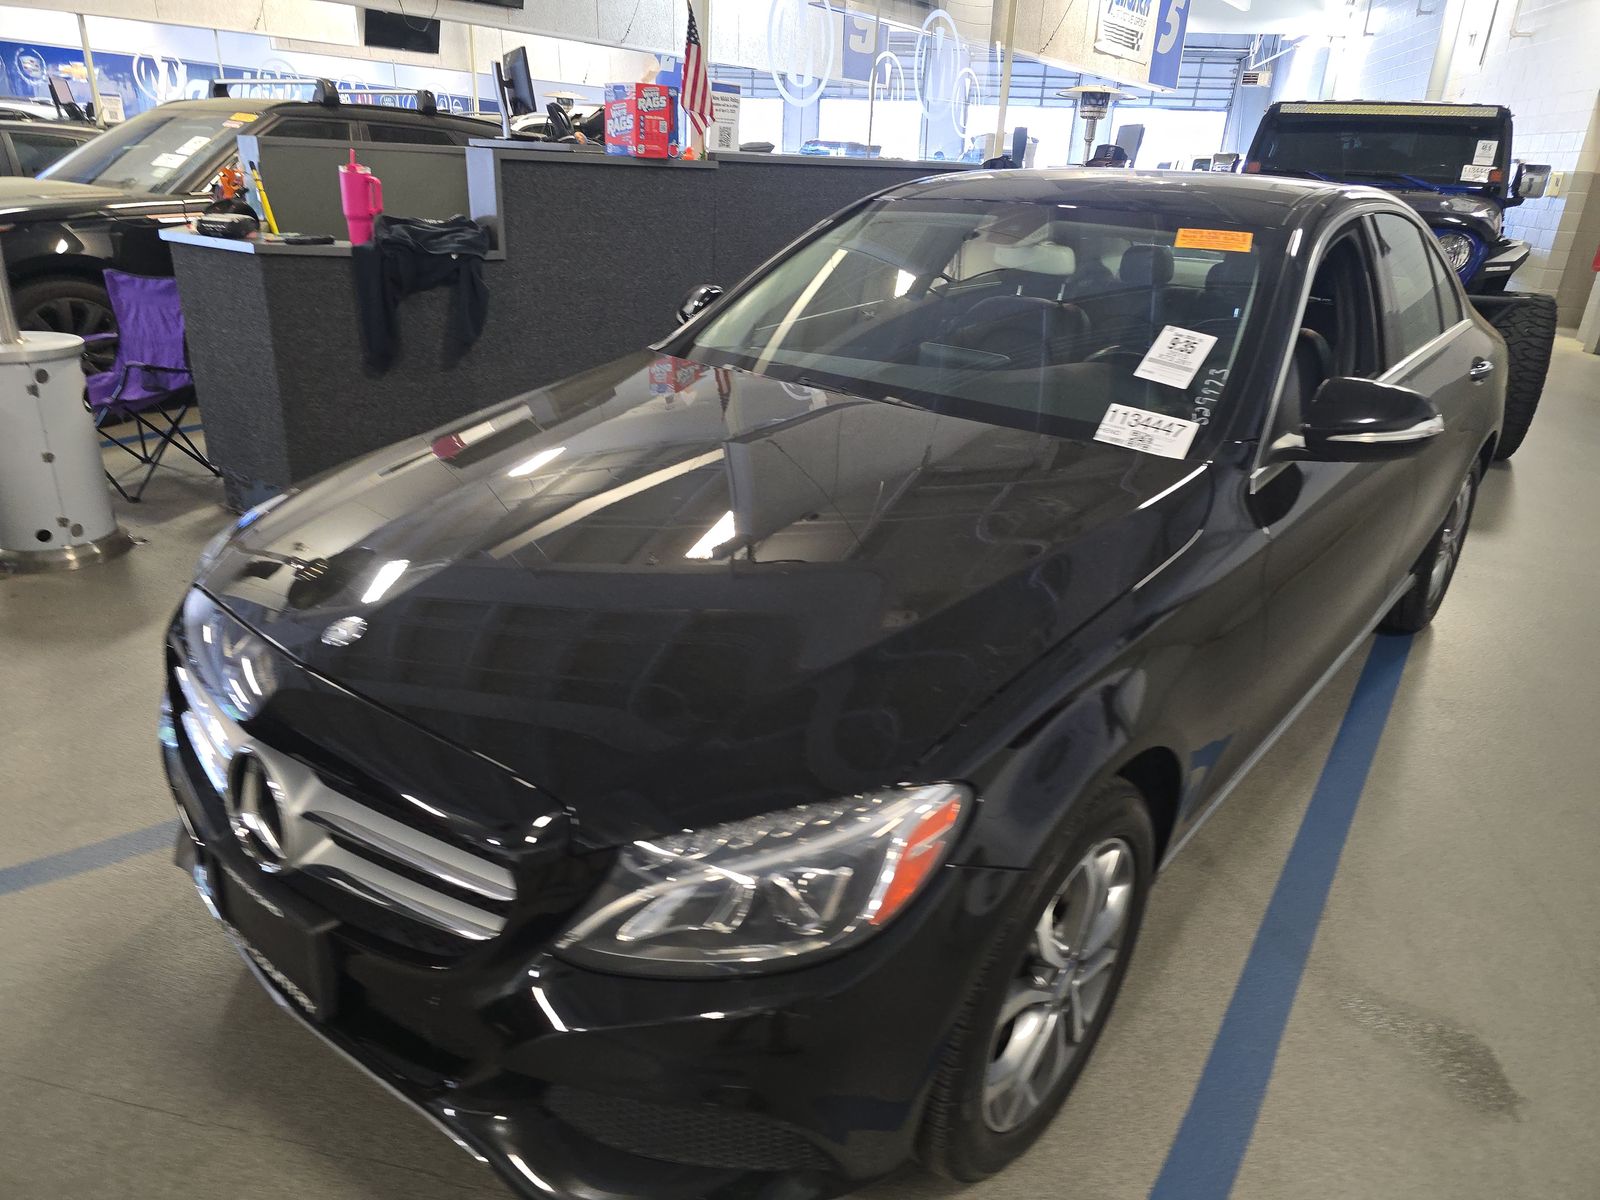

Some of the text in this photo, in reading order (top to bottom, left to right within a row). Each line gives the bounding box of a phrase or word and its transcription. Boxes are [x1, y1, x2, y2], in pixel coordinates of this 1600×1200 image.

[1156, 0, 1186, 54] 5
[637, 95, 667, 112] RAGS
[607, 113, 634, 138] RAGS
[1108, 408, 1188, 438] 1134447
